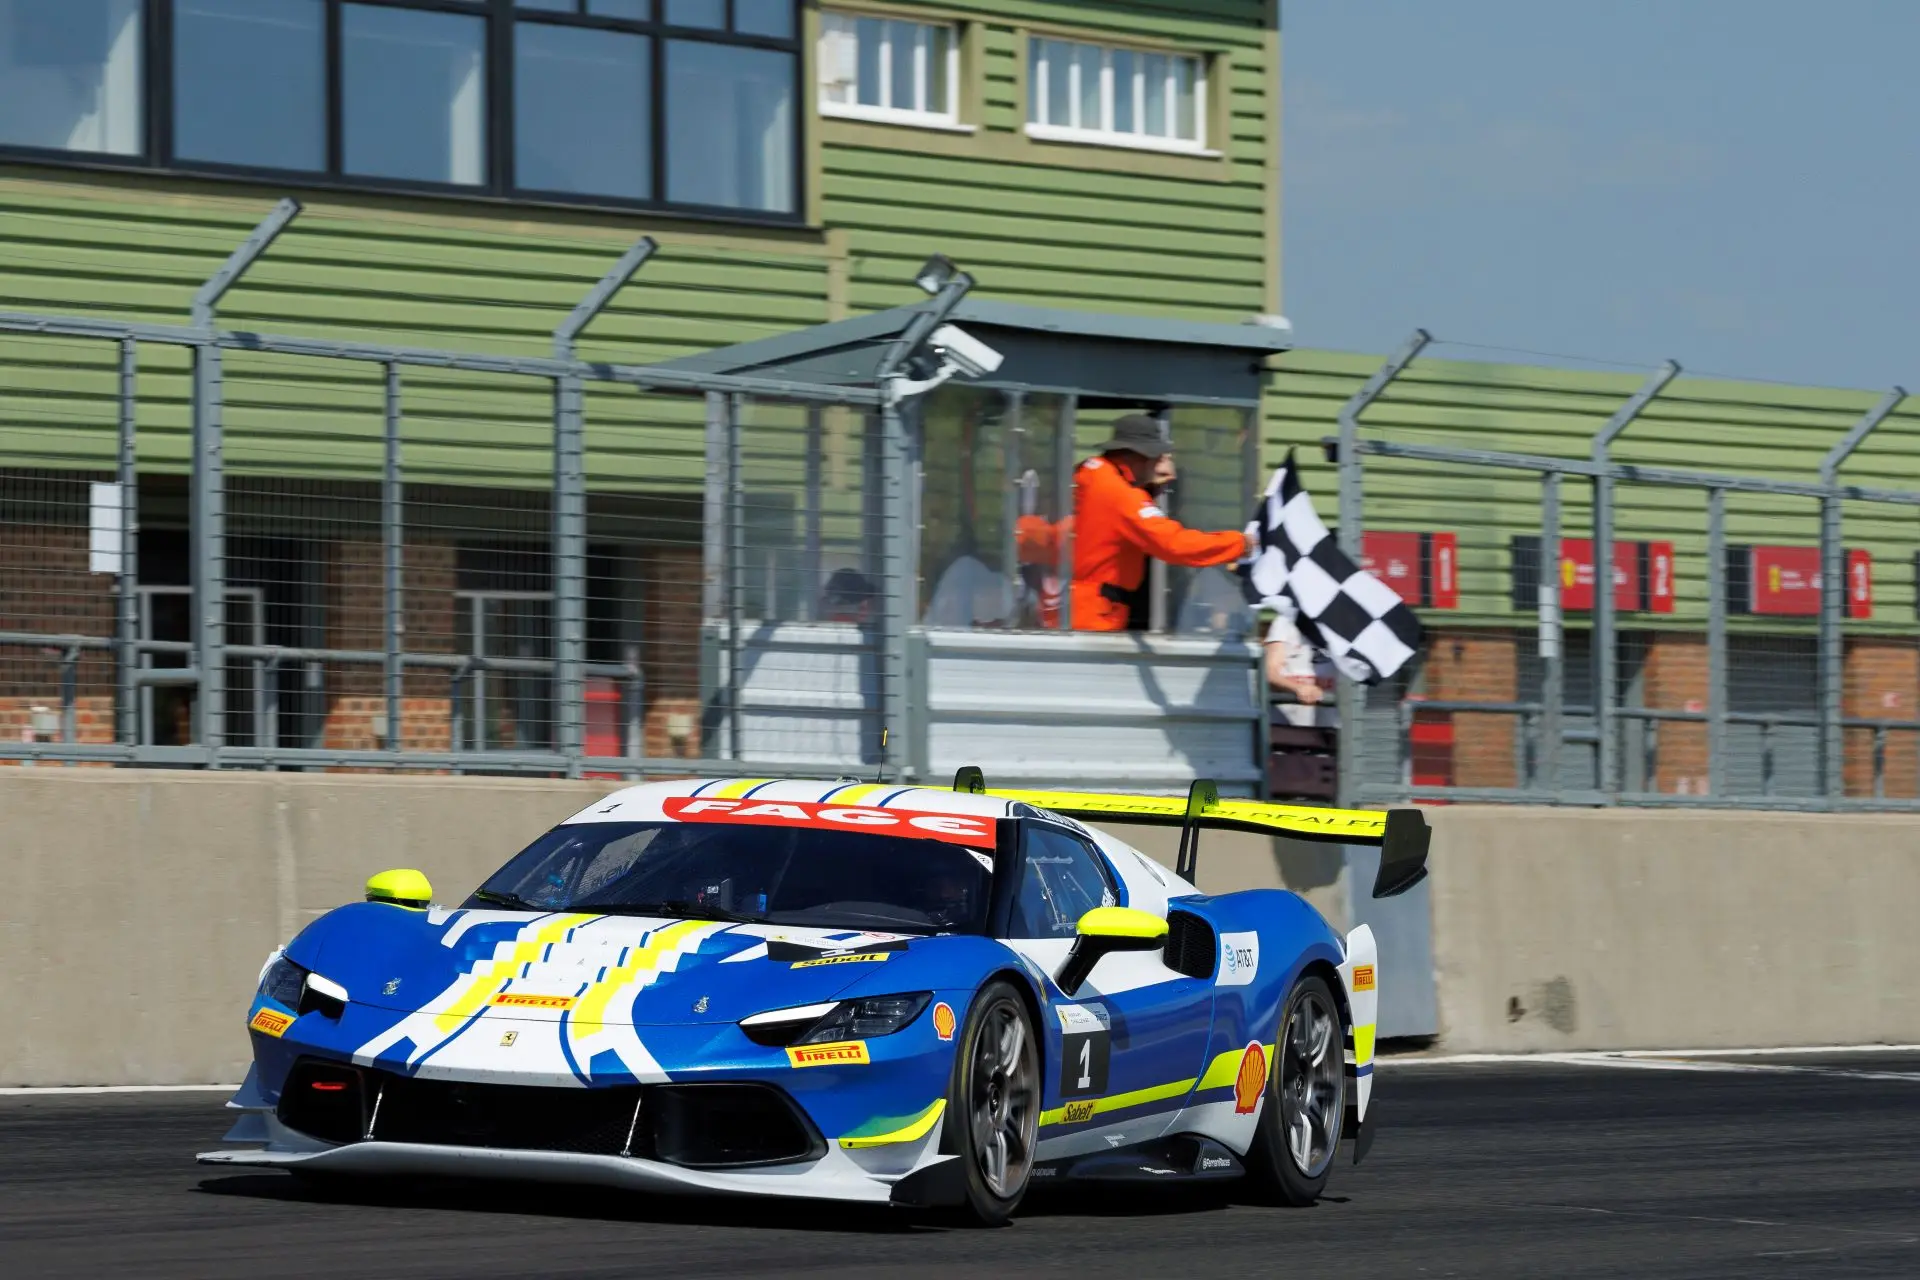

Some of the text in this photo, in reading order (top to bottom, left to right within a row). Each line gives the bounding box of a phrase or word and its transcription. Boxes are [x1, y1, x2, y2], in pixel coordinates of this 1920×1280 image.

[678, 800, 988, 836] FAGE
[802, 953, 880, 967] Sabelt
[1236, 949, 1255, 968] AT&T
[1354, 969, 1373, 985] PIRELLI
[496, 994, 571, 1006] PIRELLI
[253, 1012, 288, 1032] PIRELLI
[794, 1045, 861, 1062] PIRELLI
[1077, 1039, 1091, 1089] 1
[1063, 1102, 1094, 1122] Sabelt
